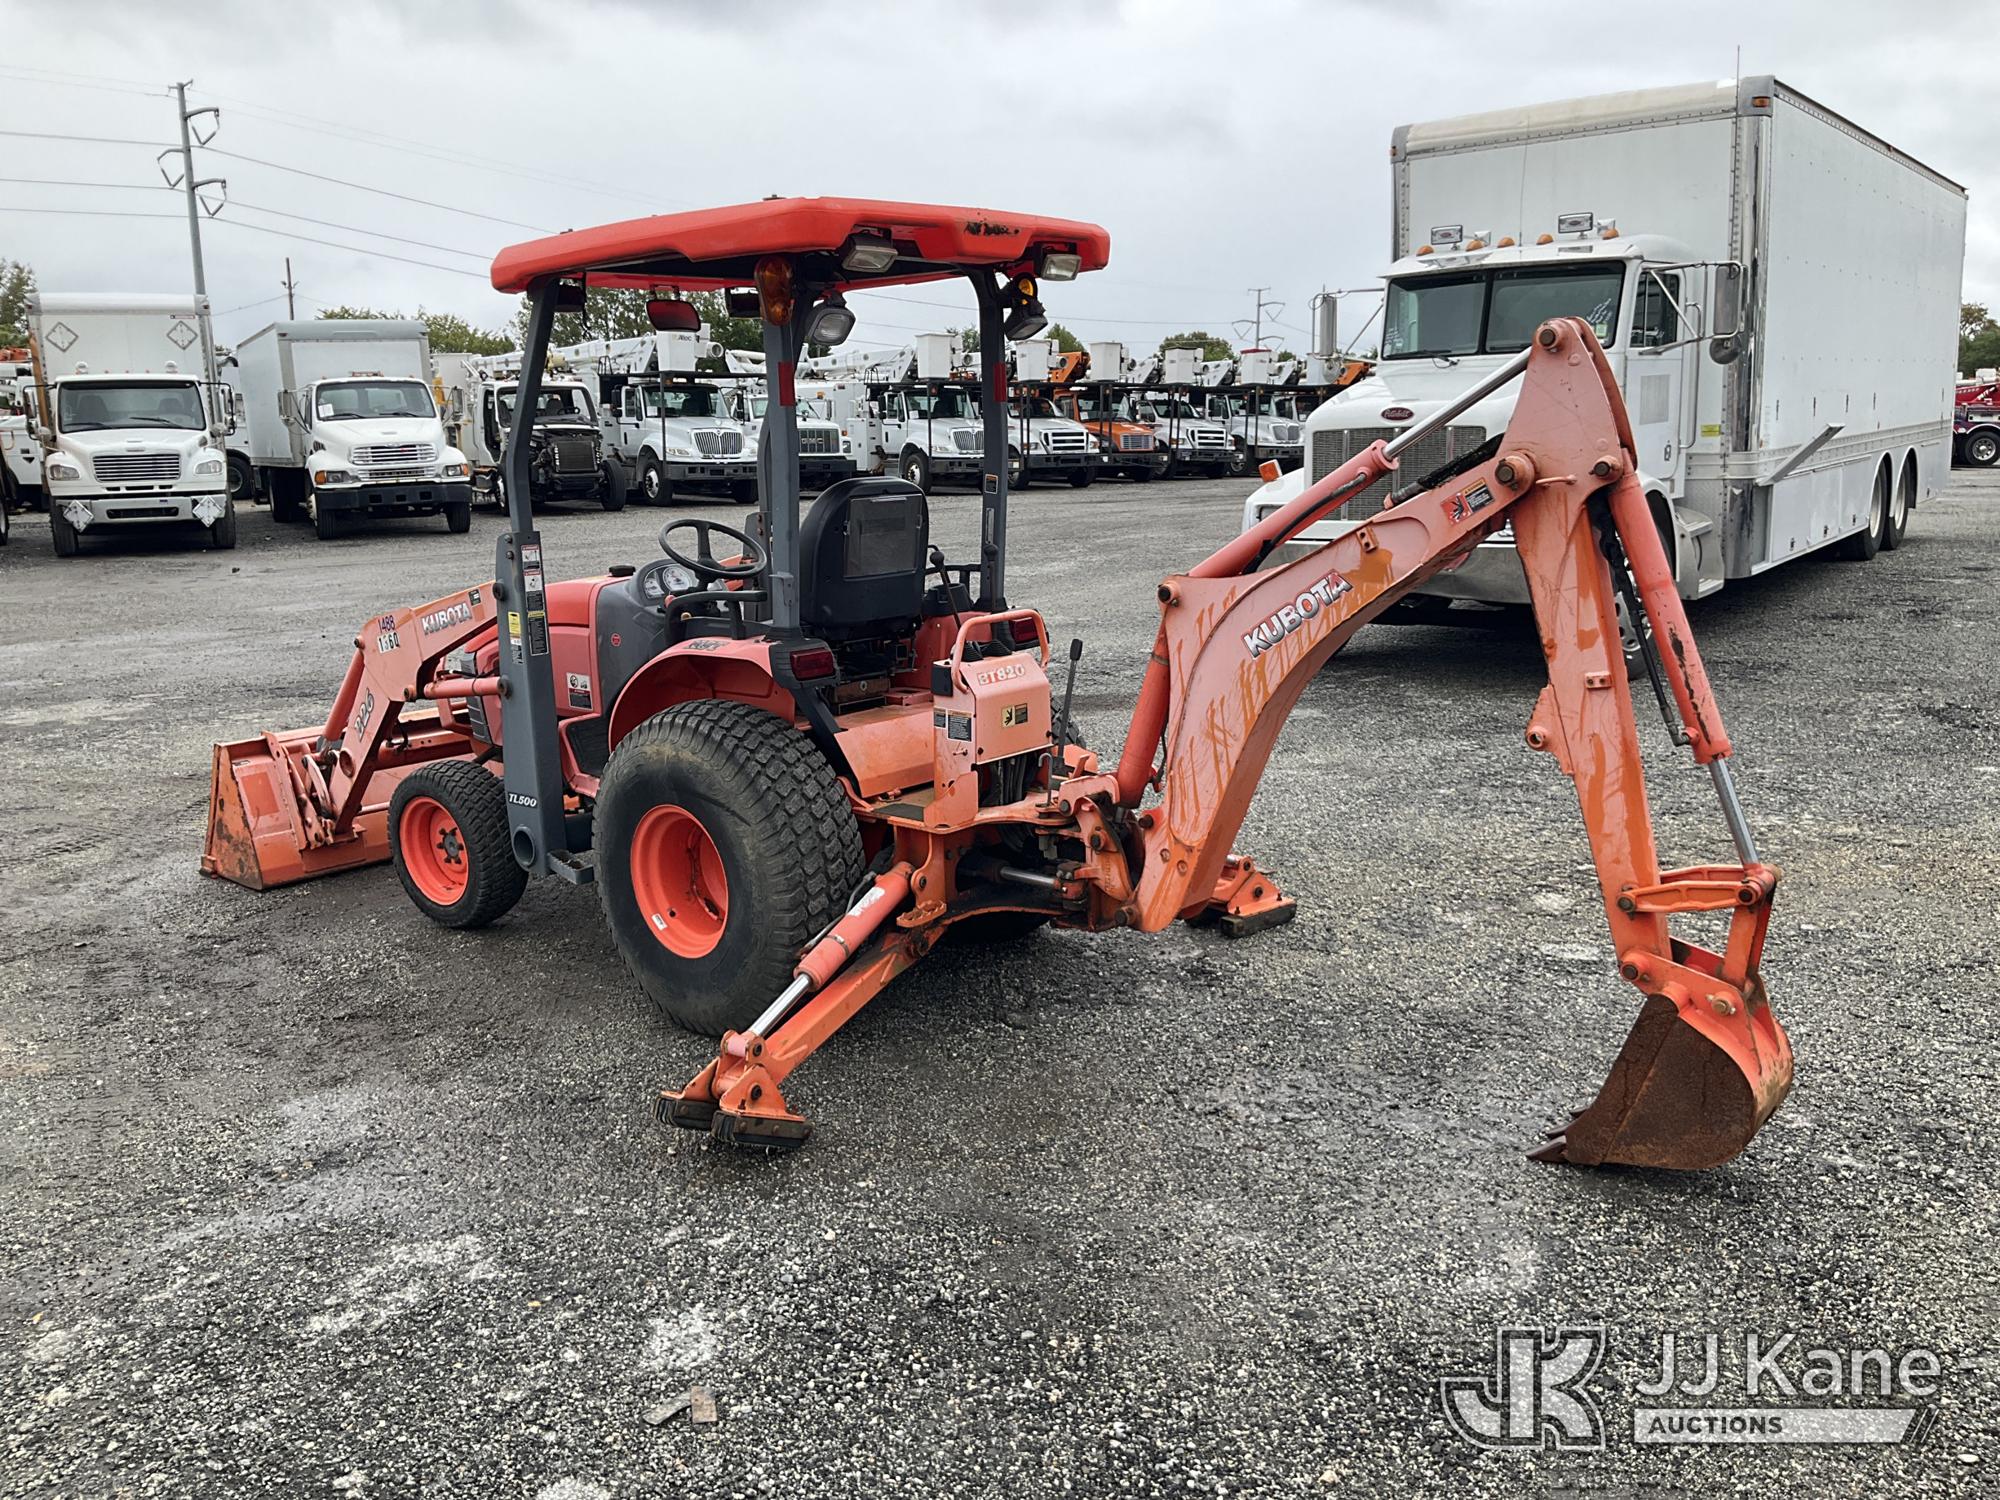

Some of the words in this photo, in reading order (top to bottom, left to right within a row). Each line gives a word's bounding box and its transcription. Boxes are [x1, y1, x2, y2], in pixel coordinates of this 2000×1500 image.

[801, 437, 824, 445] GMC
[377, 615, 396, 634] 1488
[421, 602, 473, 636] KUBOTA
[1243, 571, 1354, 659] KUBOTA
[977, 664, 1026, 686] BT820
[508, 792, 538, 808] TL500
